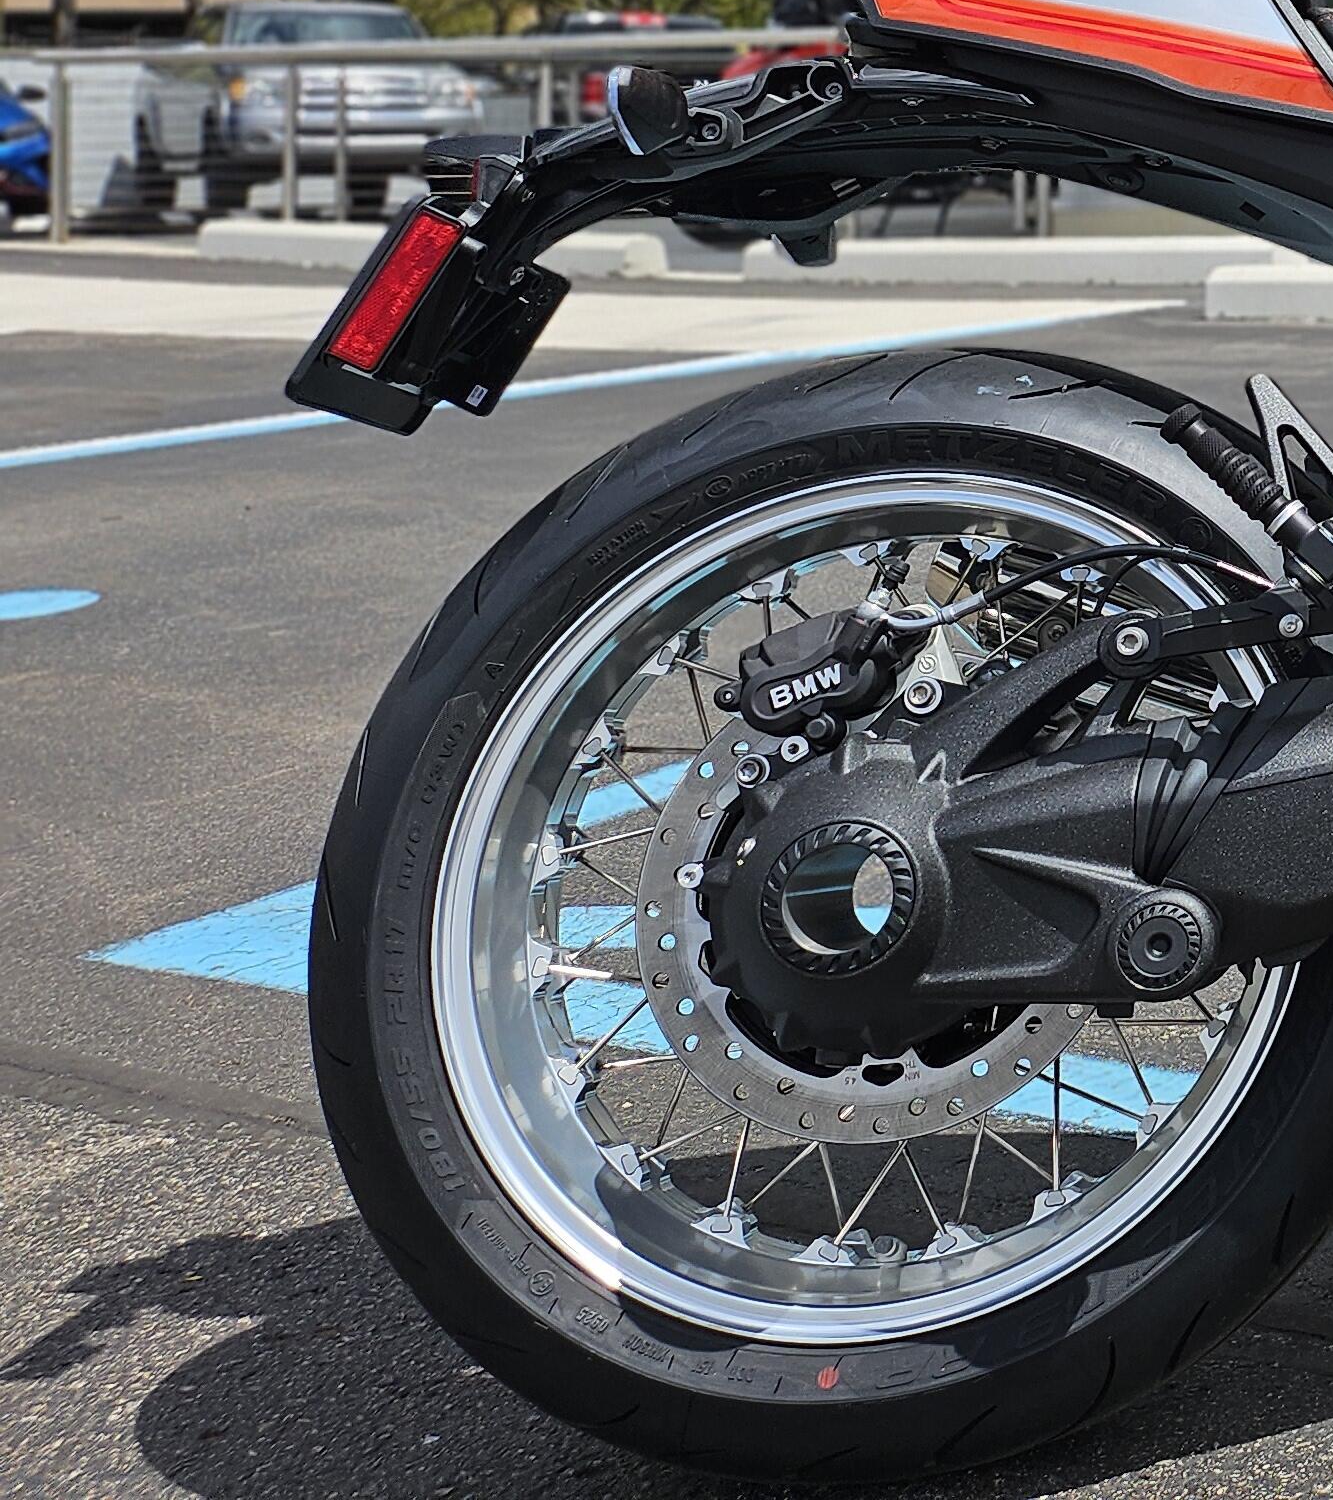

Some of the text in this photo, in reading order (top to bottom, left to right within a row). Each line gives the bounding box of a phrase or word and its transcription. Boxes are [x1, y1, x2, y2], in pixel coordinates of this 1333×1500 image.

[769, 662, 842, 710] BMW
[395, 1053, 468, 1195] 180/55
[571, 1303, 613, 1339] 0925
